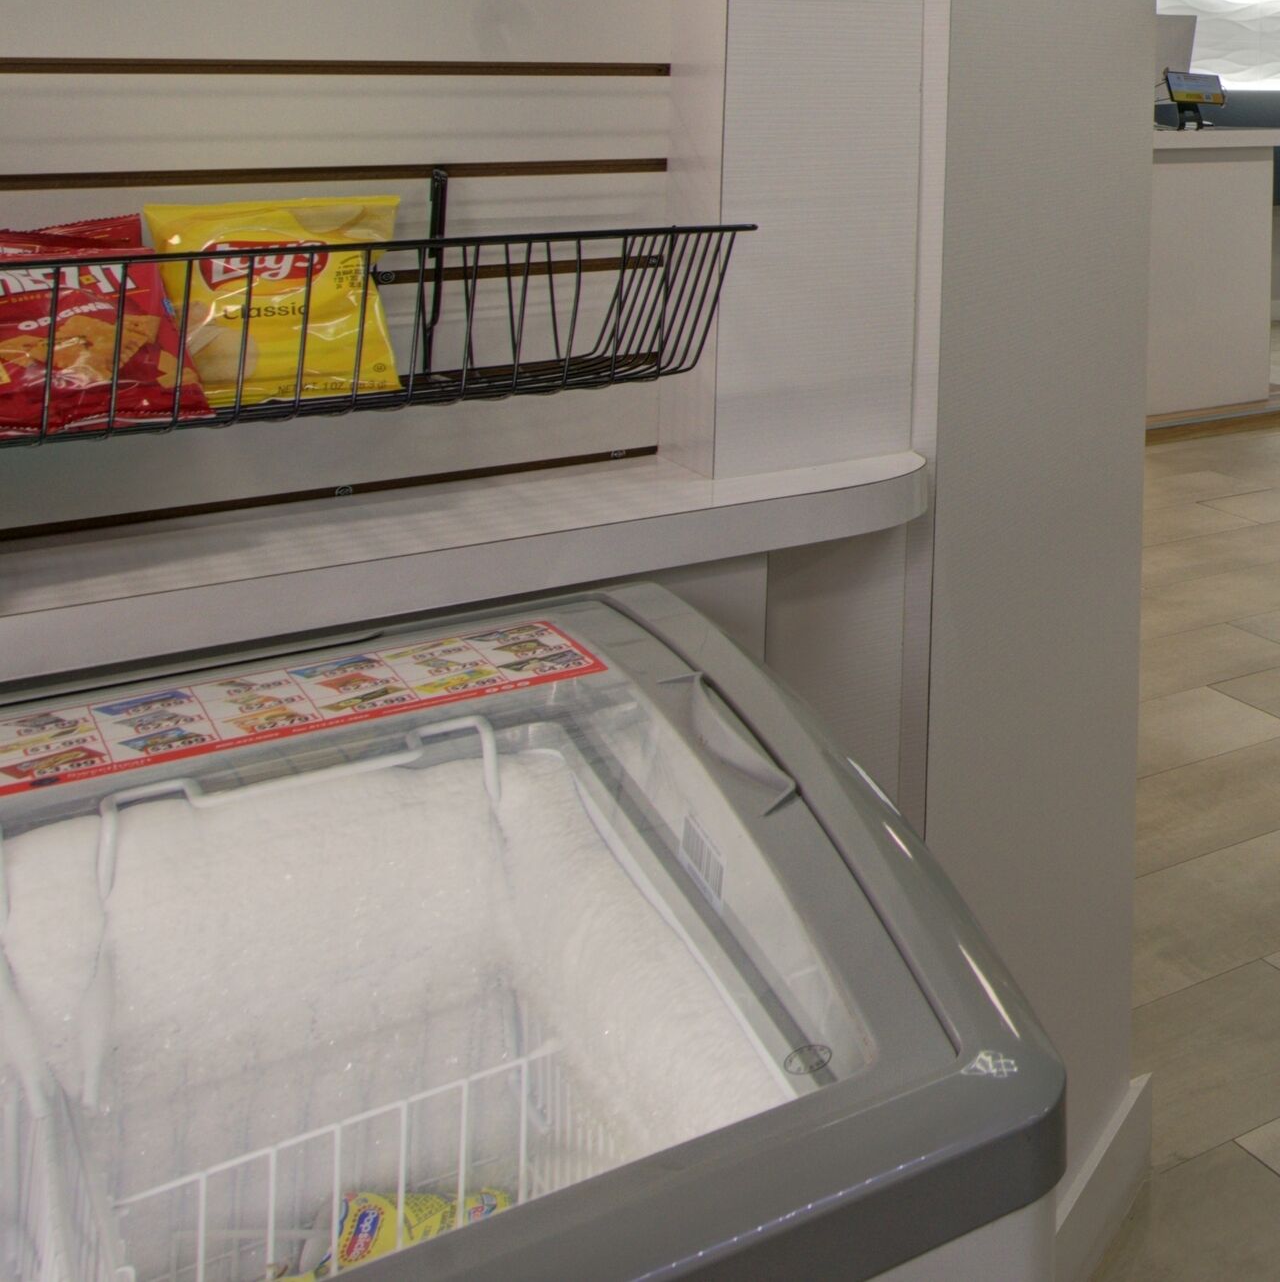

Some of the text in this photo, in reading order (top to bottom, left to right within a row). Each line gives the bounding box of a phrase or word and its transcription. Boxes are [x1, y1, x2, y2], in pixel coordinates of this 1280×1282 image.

[211, 241, 318, 285] Lay's
[223, 302, 308, 321] Classic
[356, 694, 408, 710] $3.99
[255, 714, 311, 730] $2.79
[149, 736, 207, 753] $3.99
[35, 758, 96, 776] $3.99
[349, 1207, 378, 1261] Popsicle
